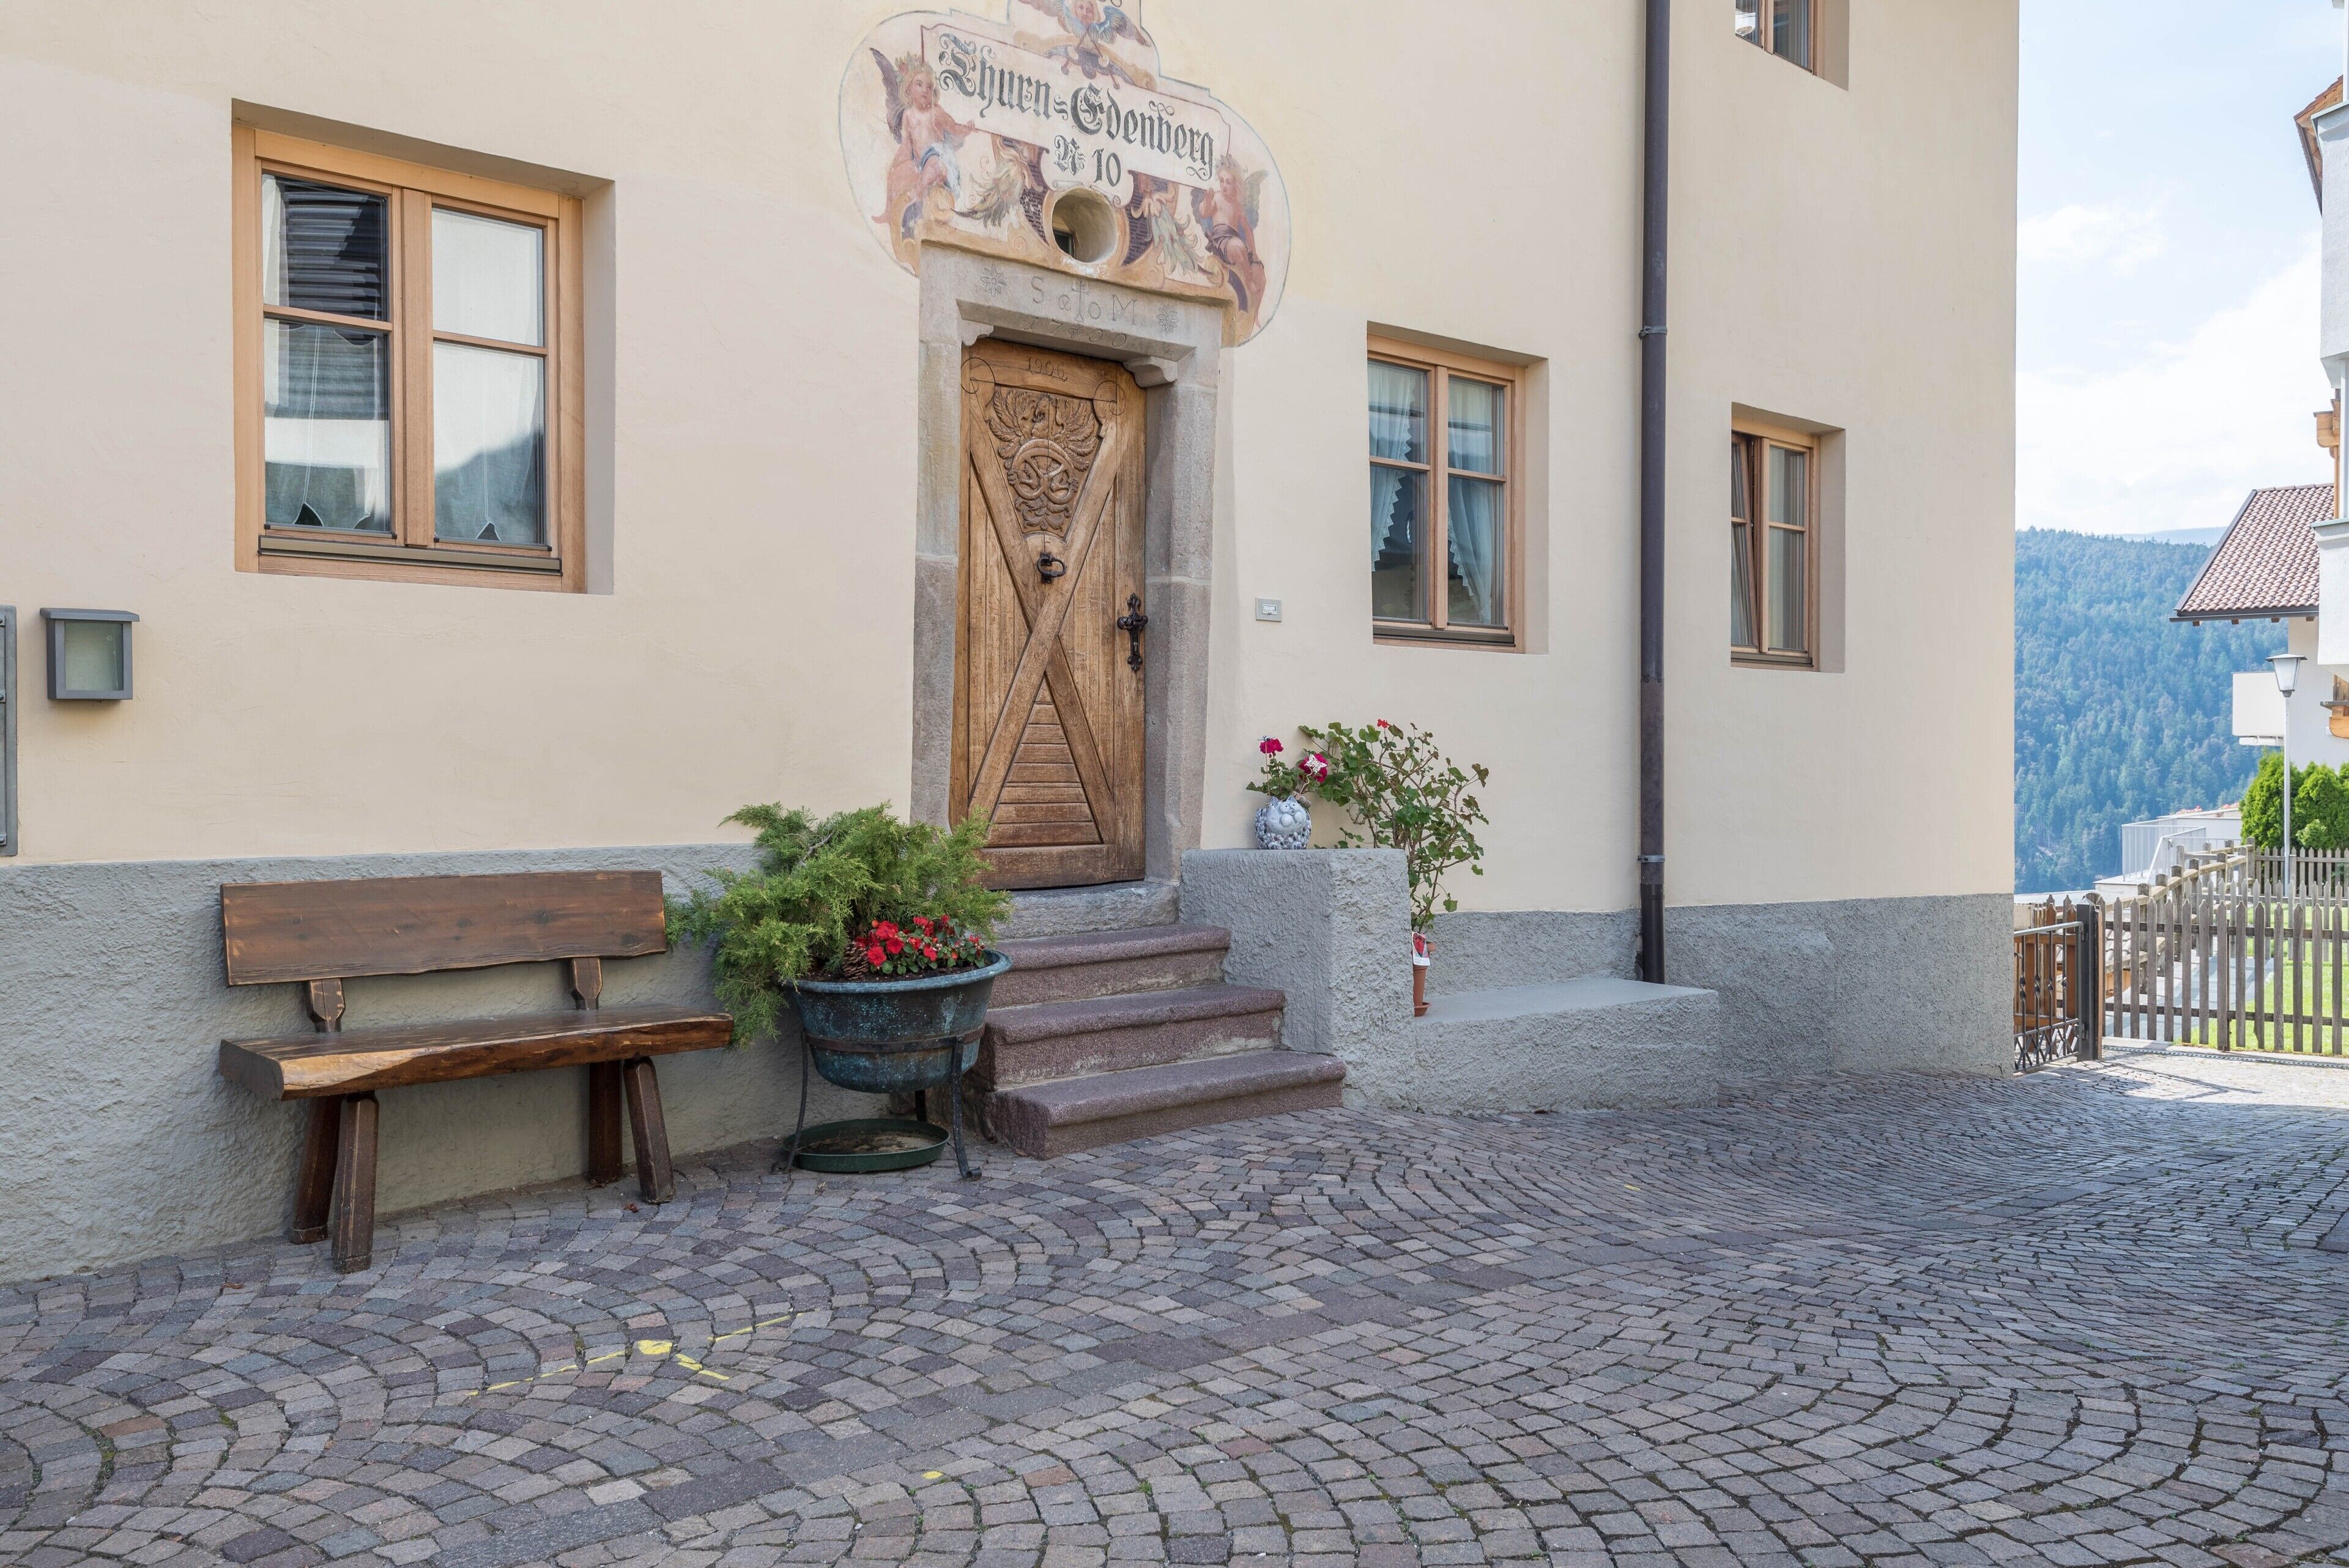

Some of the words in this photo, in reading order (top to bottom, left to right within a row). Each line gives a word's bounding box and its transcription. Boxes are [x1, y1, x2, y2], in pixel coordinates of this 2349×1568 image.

[1092, 148, 1121, 187] 10
[1031, 276, 1044, 304] S
[1111, 294, 1137, 325] M
